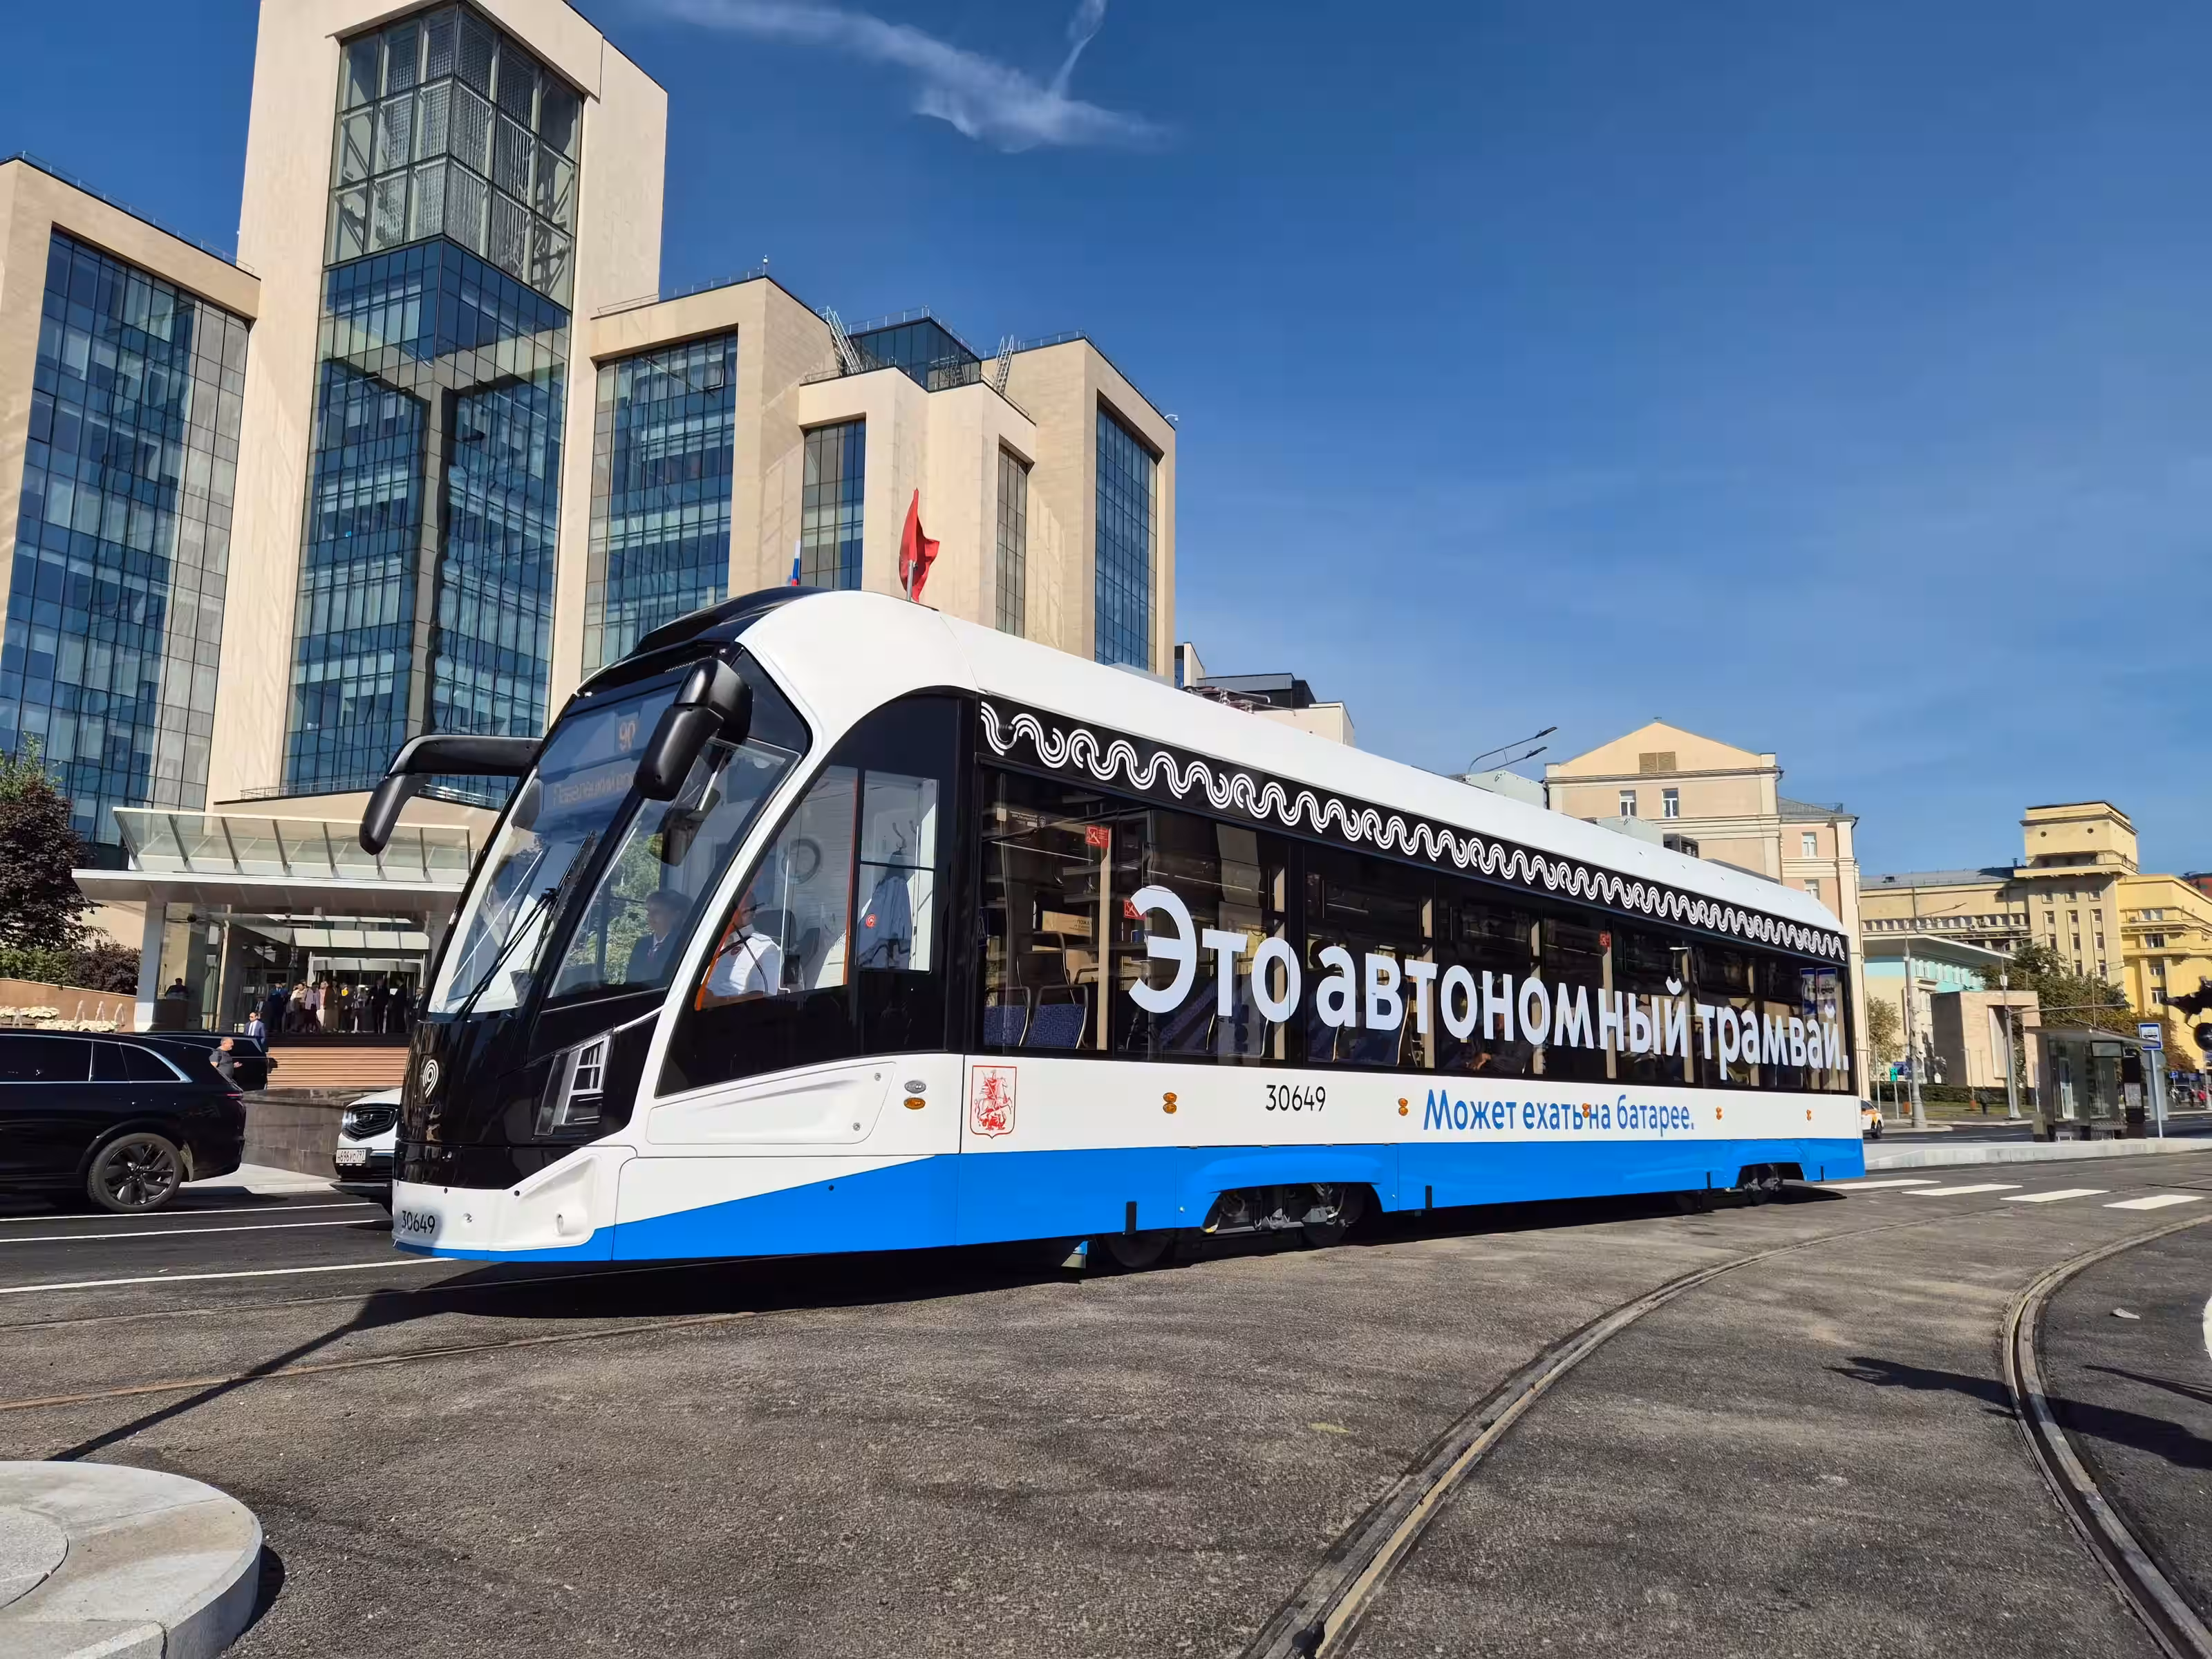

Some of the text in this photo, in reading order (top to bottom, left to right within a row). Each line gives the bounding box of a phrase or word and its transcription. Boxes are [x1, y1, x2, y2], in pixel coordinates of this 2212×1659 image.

[1128, 885, 1849, 1080] Это автономный трамвай.
[1265, 1085, 1326, 1112] 30649
[1423, 1089, 1694, 1137] Может ехать на батарее.
[402, 1210, 435, 1234] 30649
